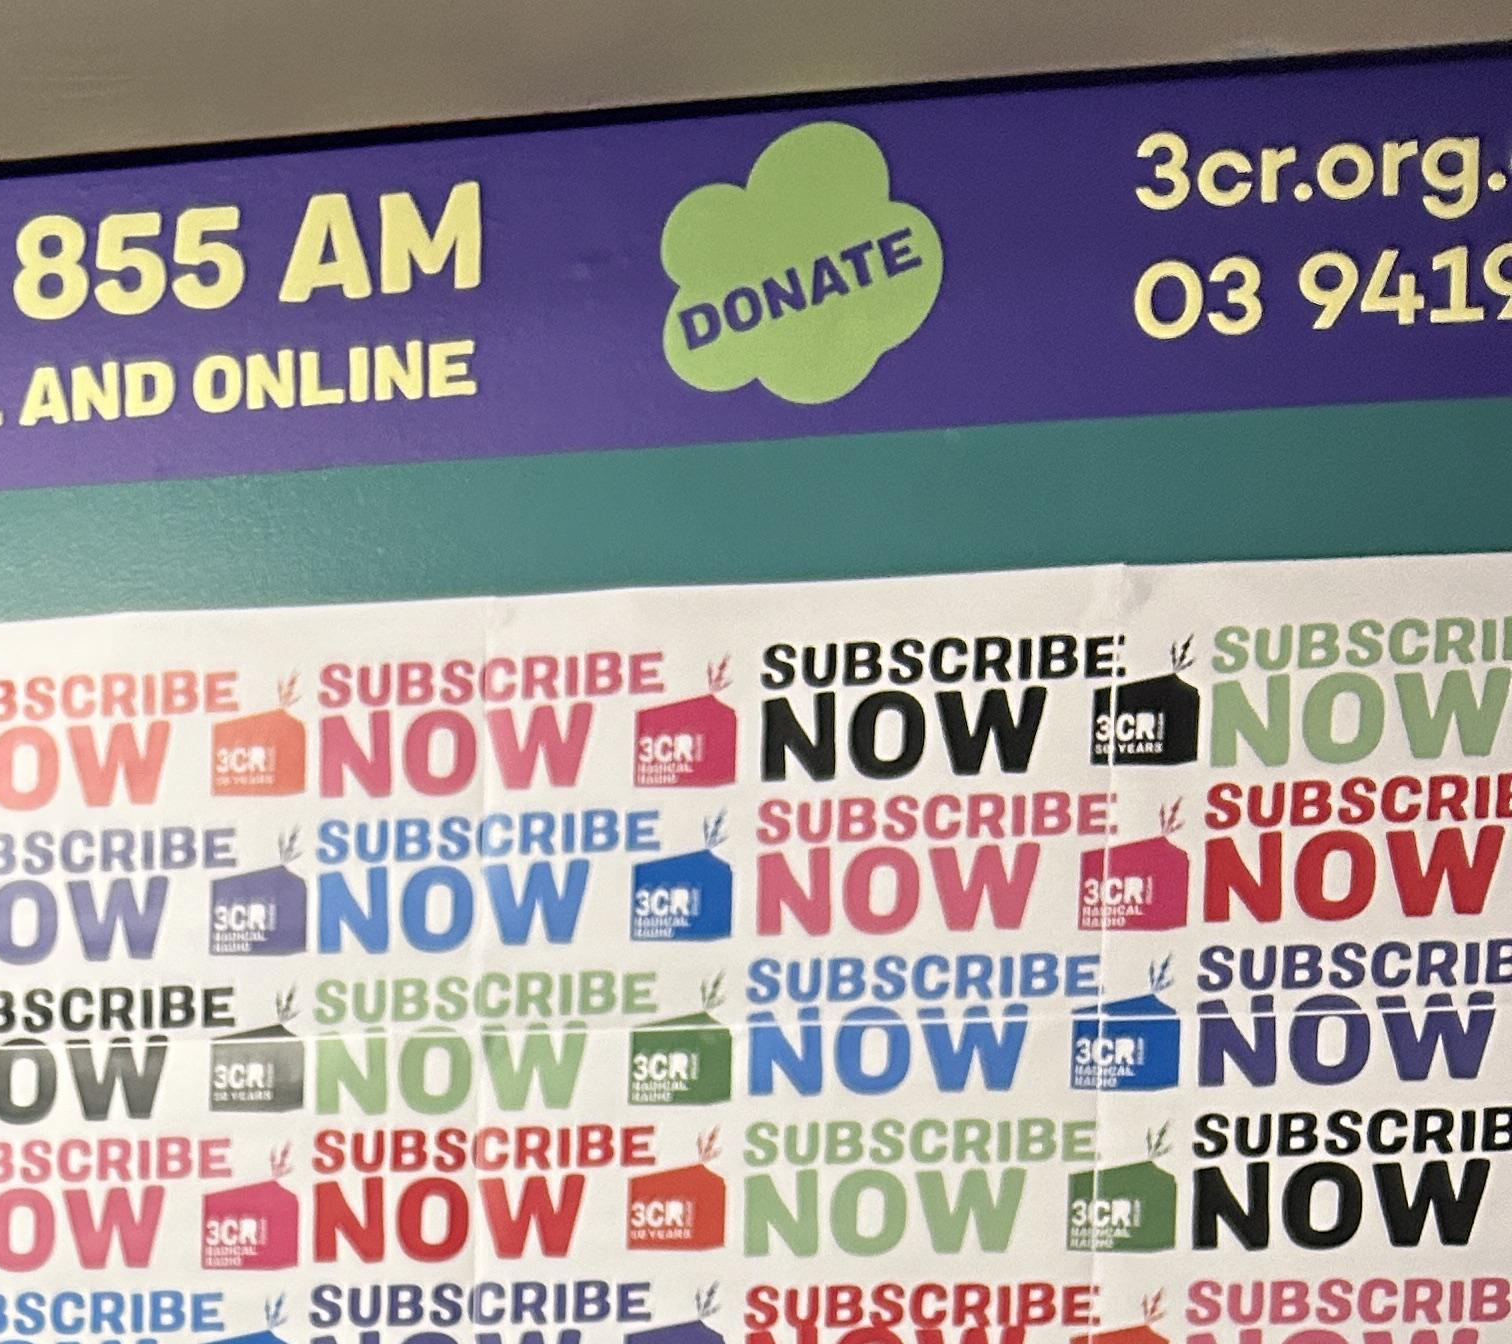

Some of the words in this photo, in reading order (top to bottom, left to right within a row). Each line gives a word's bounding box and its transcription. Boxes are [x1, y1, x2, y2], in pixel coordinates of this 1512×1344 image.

[1134, 130, 1512, 221] 3cr.org.
[12, 206, 245, 322] 855
[277, 181, 483, 305] AM
[678, 227, 923, 353] DONATE
[1134, 256, 1264, 340] 03
[19, 359, 175, 427] AND
[192, 339, 478, 415] ONLINE
[319, 651, 664, 708] SUBSCRIBE
[762, 635, 1126, 689] SUBSCRIBE
[320, 702, 593, 798] NOW
[639, 734, 692, 763] 3CR
[762, 686, 1047, 781] NOW
[1210, 667, 1512, 768] NOW
[316, 809, 660, 864] SUBSCRIBE
[756, 791, 1118, 845] SUBSCRIBE
[318, 859, 590, 954] NOW
[757, 842, 1040, 936] NOW
[1084, 876, 1144, 905] 3CR
[1203, 825, 1505, 923] NOW
[314, 970, 658, 1025] SUBSCRIBE
[746, 953, 1100, 1004] SUBSCRIBE
[633, 1052, 688, 1081] 3CR
[312, 1124, 656, 1174] SUBSCRIBE
[743, 1117, 1097, 1167] SUBSCRIBE
[205, 1218, 258, 1247] 3CR
[314, 1174, 585, 1263] NOW
[744, 1167, 1027, 1257] NOW
[1193, 1158, 1490, 1251] NOW
[309, 1280, 651, 1328] SUBSCRIBE
[742, 1281, 1100, 1328] SUBSCRIBE
